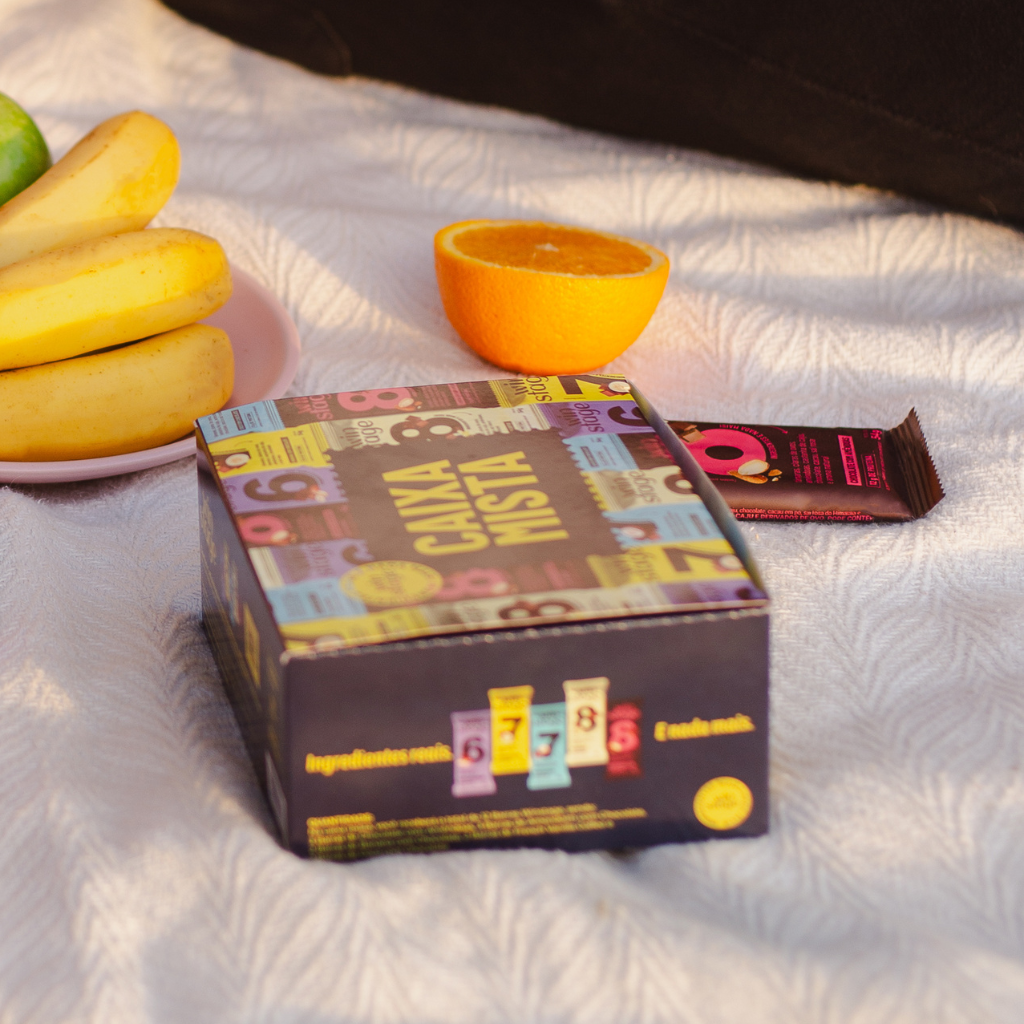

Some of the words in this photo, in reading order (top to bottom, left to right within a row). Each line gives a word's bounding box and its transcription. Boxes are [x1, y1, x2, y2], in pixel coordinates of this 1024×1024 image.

[526, 376, 553, 402] stag
[574, 402, 604, 433] stage
[358, 420, 383, 446] age
[382, 459, 490, 556] CAIXA
[457, 451, 569, 547] MISTA
[501, 716, 523, 739] 7
[576, 705, 597, 731] 8
[463, 737, 486, 763] 6
[538, 732, 560, 757] 7
